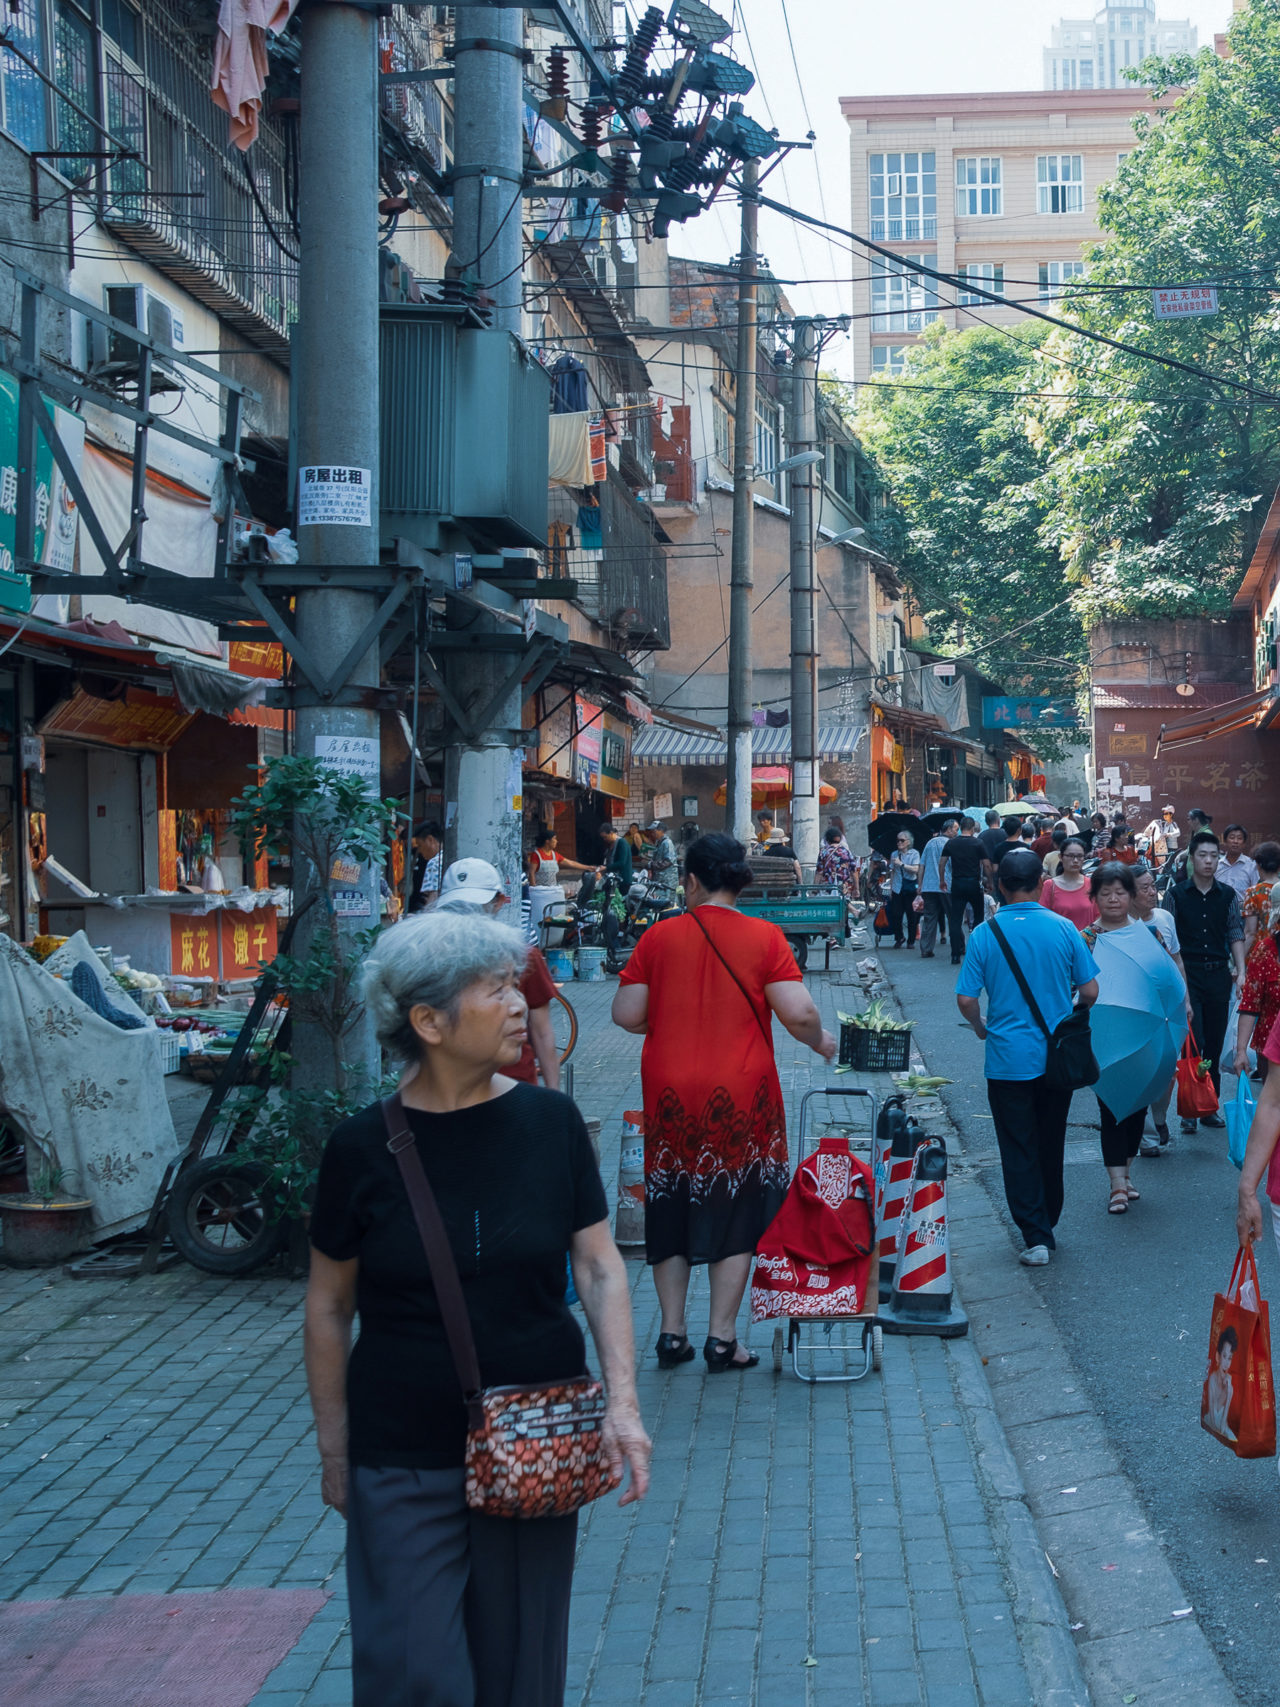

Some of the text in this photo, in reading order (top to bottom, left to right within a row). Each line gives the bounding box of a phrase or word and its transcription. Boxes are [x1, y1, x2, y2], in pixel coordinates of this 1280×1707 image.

[1159, 288, 1211, 302] 禁止无规划
[305, 470, 362, 485] 房屋出租
[1129, 763, 1269, 793] 良平茗茶
[182, 927, 211, 972] 麻花
[757, 1253, 789, 1272] Comfort
